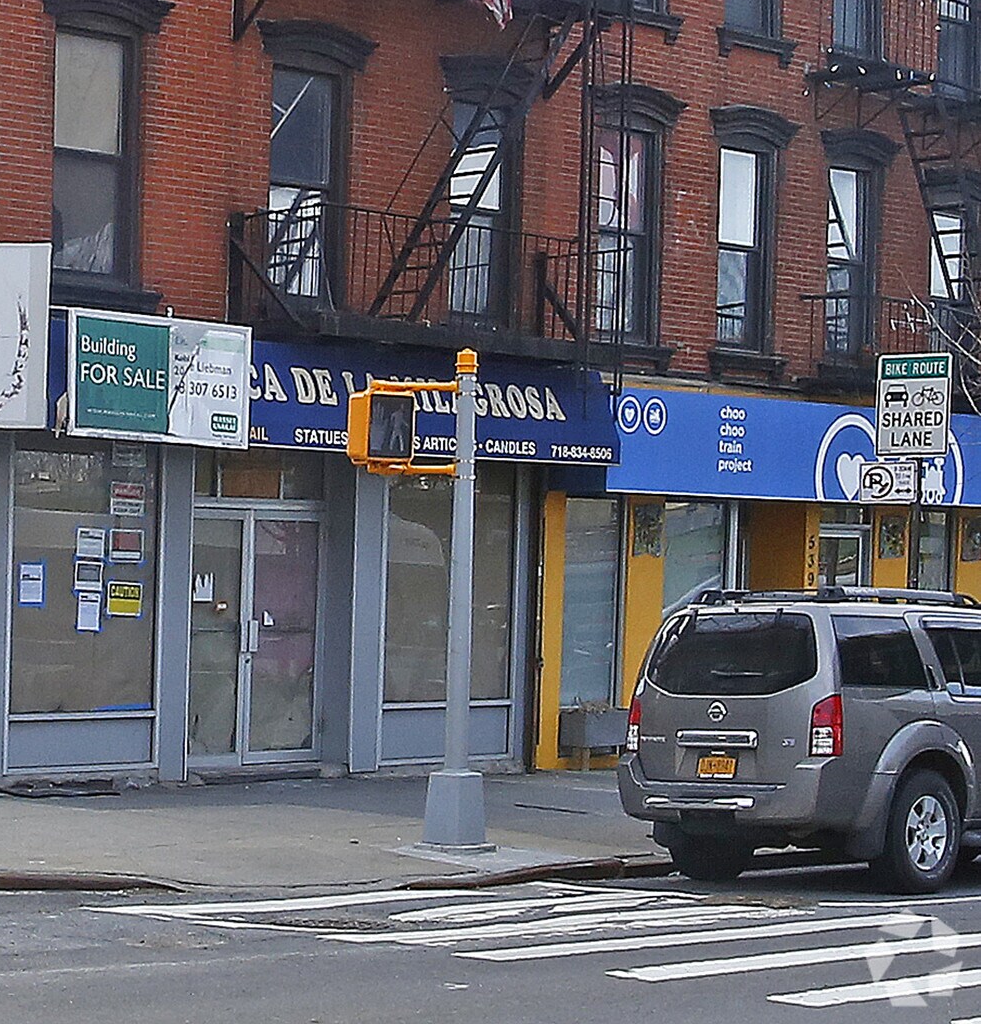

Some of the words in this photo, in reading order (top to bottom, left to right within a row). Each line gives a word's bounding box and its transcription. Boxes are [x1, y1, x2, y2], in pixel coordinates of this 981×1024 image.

[80, 335, 137, 361] Building
[80, 363, 119, 385] FOR
[123, 367, 166, 389] SALE
[885, 363, 907, 375] BIKE
[912, 361, 945, 374] ROUTE
[189, 381, 208, 396] 307
[212, 384, 238, 399] 6513
[290, 367, 338, 406] DE
[720, 405, 746, 421] choo
[882, 411, 943, 427] SHARED
[720, 422, 746, 437] choo
[295, 428, 348, 446] STATUES
[486, 439, 536, 456] CANDLES
[719, 440, 742, 454] train
[891, 431, 933, 447] LANE
[717, 458, 752, 473] project
[111, 585, 140, 598] CAUTION
